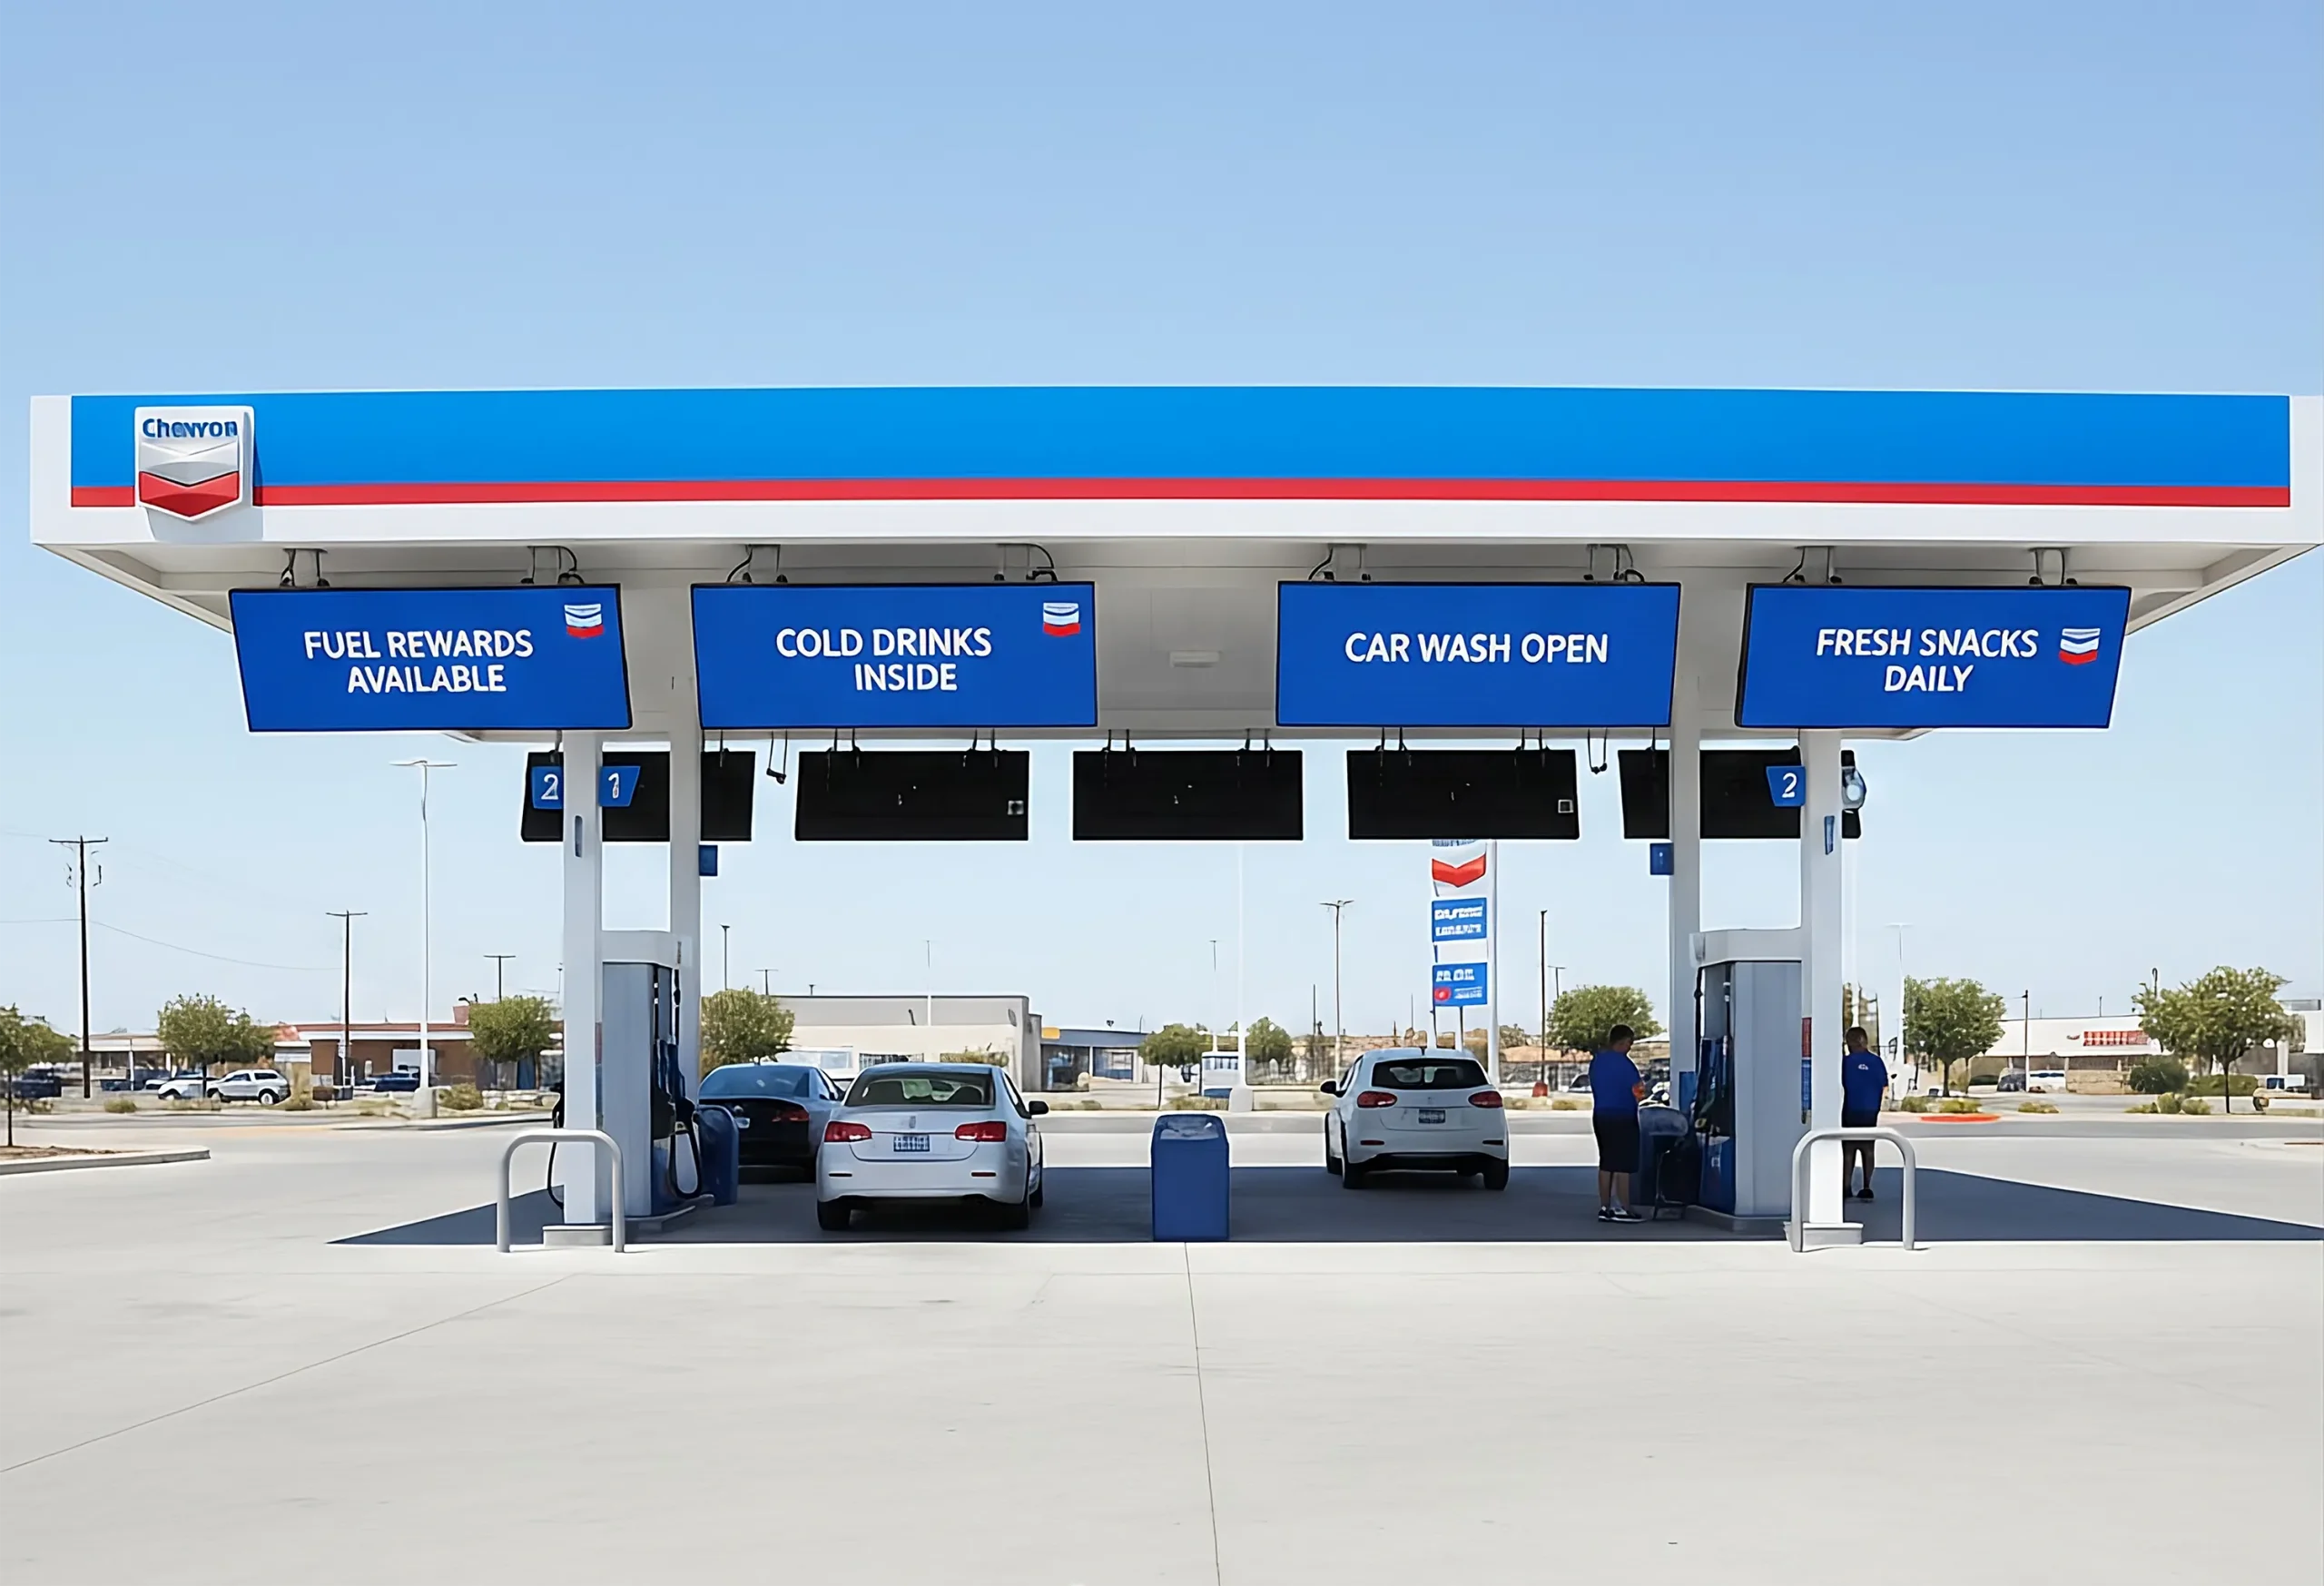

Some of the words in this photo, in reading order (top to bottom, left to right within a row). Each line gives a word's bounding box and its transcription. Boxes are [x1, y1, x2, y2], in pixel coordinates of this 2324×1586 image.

[305, 631, 380, 658] FUEL
[387, 630, 534, 658] REWARDS
[777, 628, 863, 656] COLD
[873, 627, 992, 656] DRINKS
[1345, 633, 1410, 663] CAR
[1418, 633, 1511, 663] WASH
[1521, 634, 1608, 664] OPEN
[1817, 629, 1912, 656] FRESH
[1920, 628, 2039, 657] SNACKS
[349, 665, 506, 693] AVAILABLE
[855, 664, 958, 691] INSIDE
[1885, 665, 1974, 692] DAILY
[1781, 772, 1797, 798] 2
